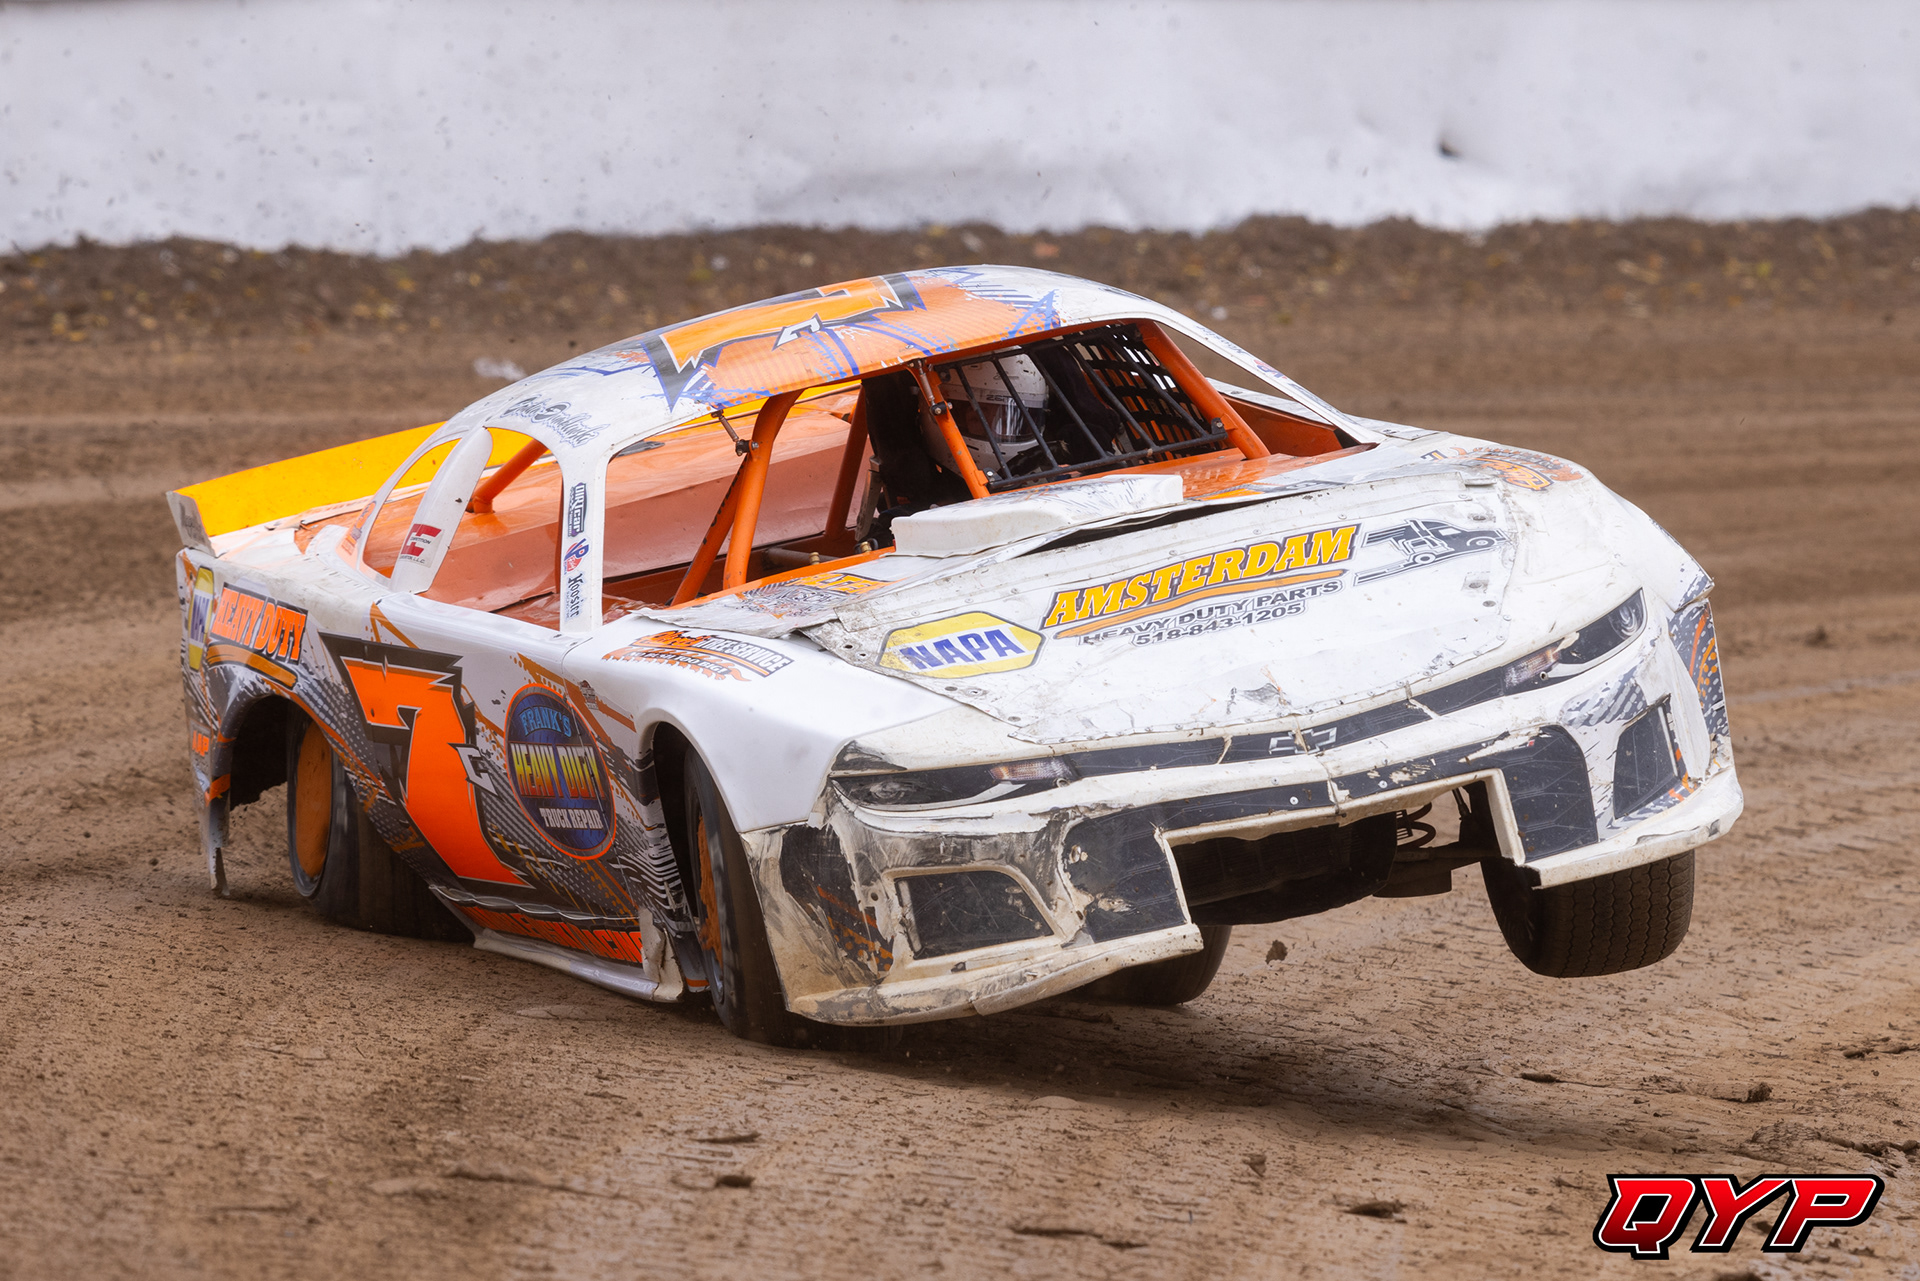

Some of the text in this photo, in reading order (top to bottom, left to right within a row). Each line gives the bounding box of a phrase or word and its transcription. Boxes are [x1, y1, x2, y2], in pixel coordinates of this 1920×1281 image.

[568, 573, 583, 617] Hoosier
[1044, 525, 1356, 627] AMSTERDAM
[212, 588, 307, 661] HEAVY DUTY
[1083, 581, 1341, 643] HEAVY DUTY PARTS
[1135, 603, 1302, 646] 518-843-1205
[723, 642, 791, 673] SERVICE
[899, 629, 1026, 670] NAPA
[519, 706, 572, 738] FRANK'S
[510, 743, 605, 798] HEAVY DUTY
[539, 808, 603, 829] TRUCK REPAIR
